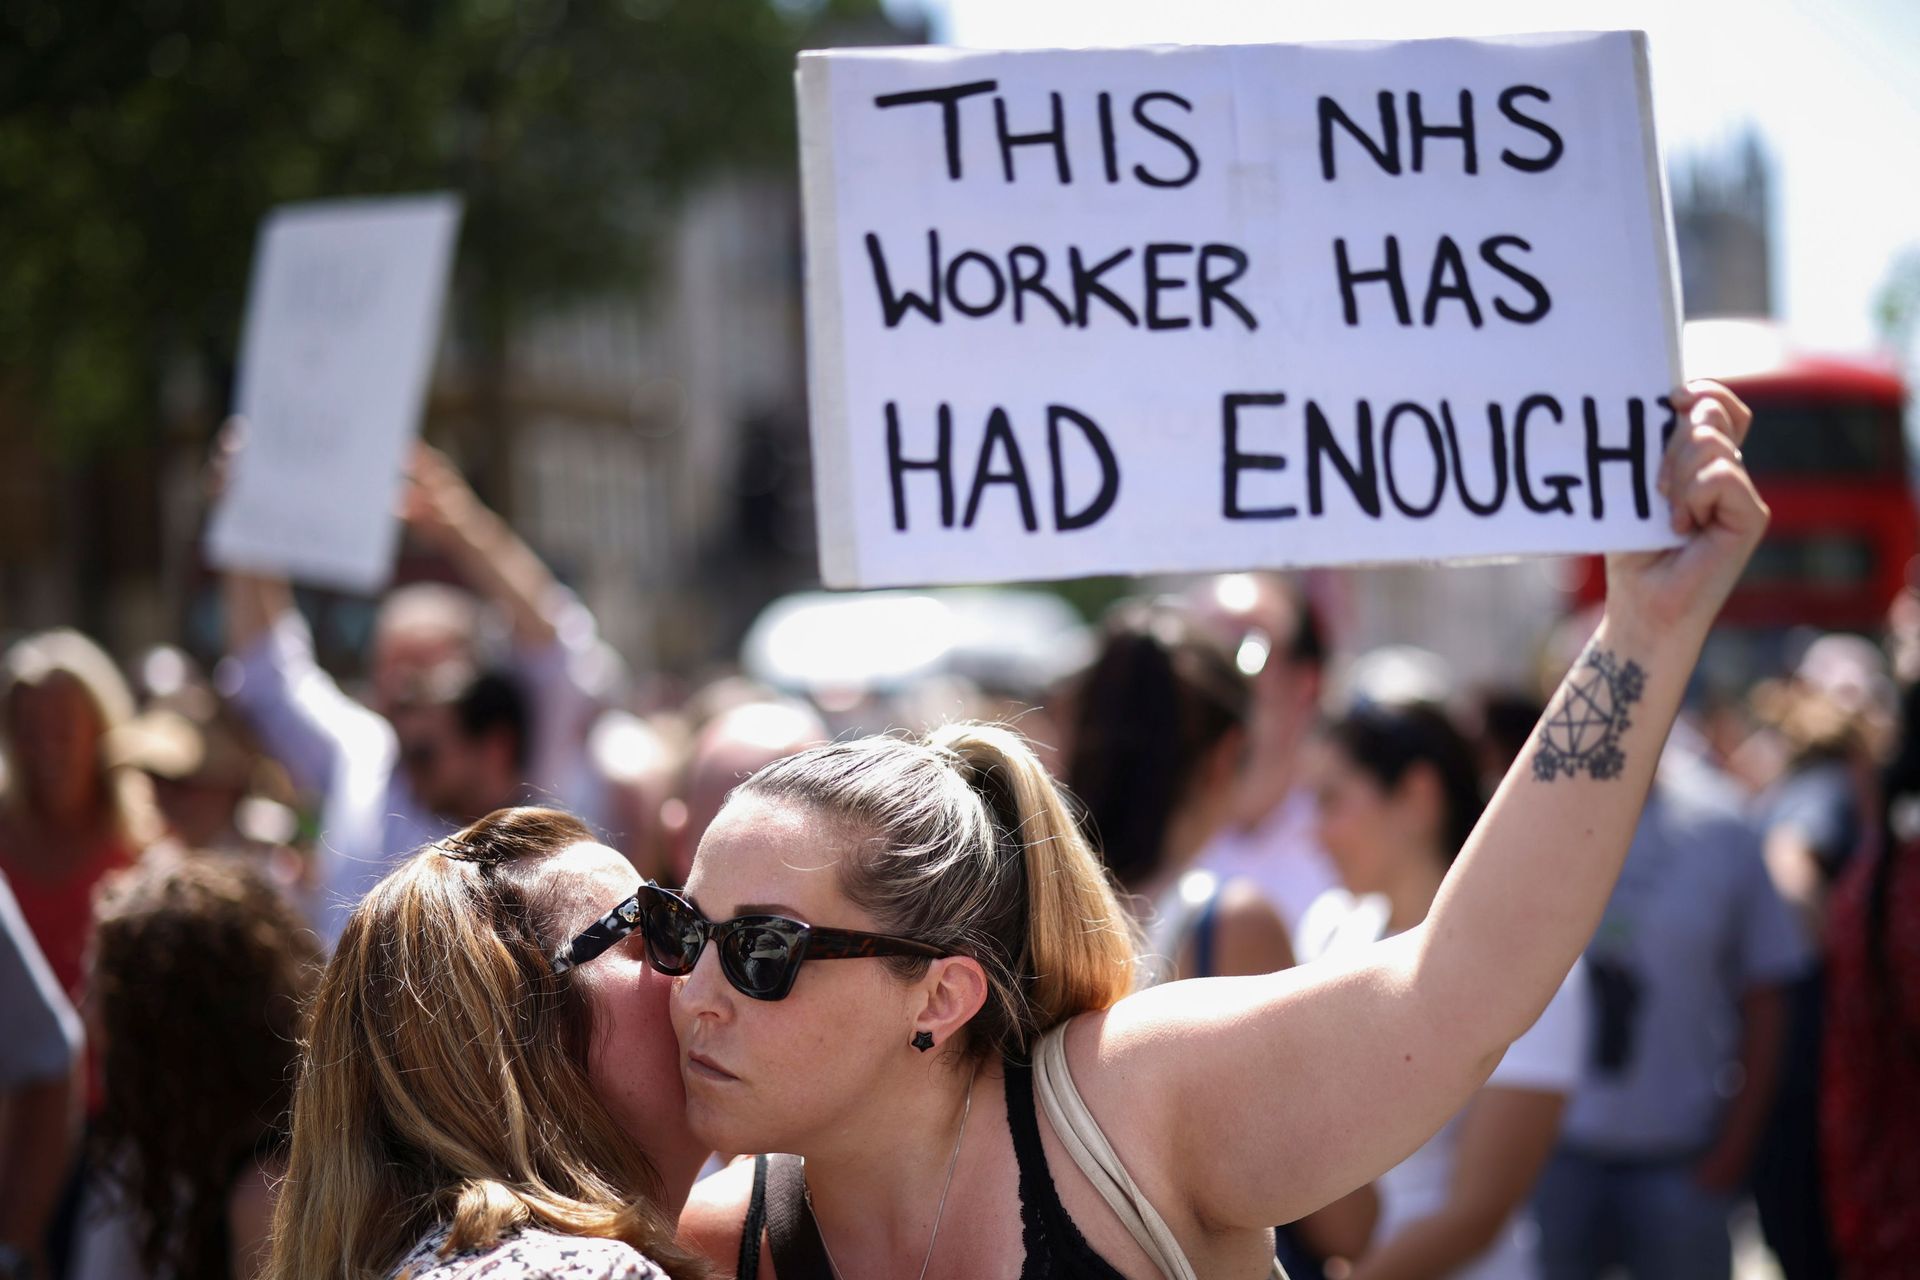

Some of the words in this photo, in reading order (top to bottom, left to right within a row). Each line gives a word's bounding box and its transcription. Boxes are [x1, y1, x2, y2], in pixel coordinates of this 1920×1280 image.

[874, 80, 1200, 188] THIS
[1318, 85, 1564, 181] NHS
[865, 230, 1258, 330] WORKER
[1334, 235, 1551, 328] HAS
[885, 402, 1119, 532] HAD
